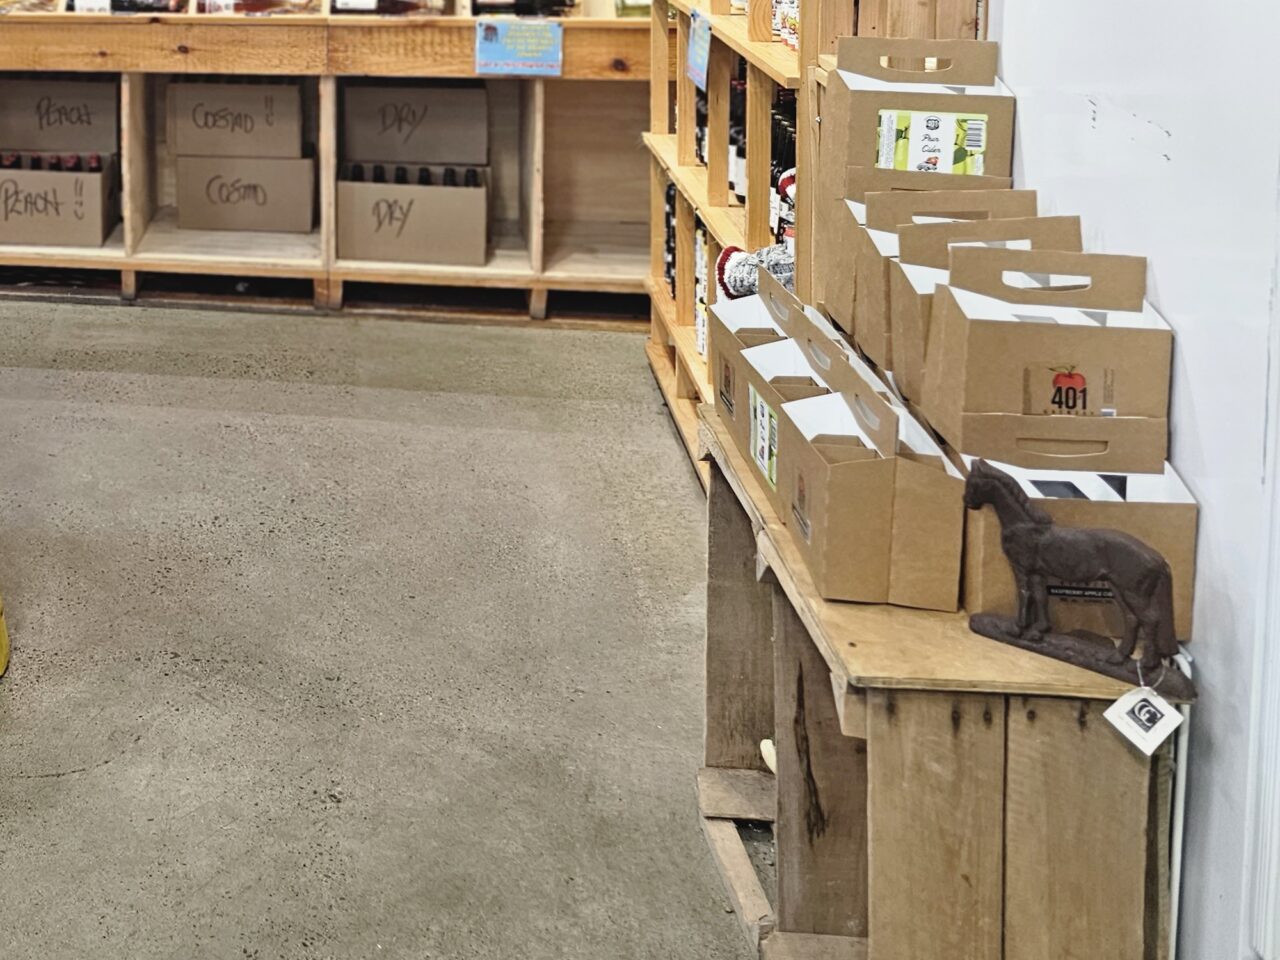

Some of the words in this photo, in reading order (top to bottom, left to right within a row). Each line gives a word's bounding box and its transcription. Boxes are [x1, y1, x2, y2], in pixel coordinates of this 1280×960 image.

[377, 102, 428, 144] DRY
[372, 198, 415, 238] DRY
[1050, 385, 1088, 410] 401
